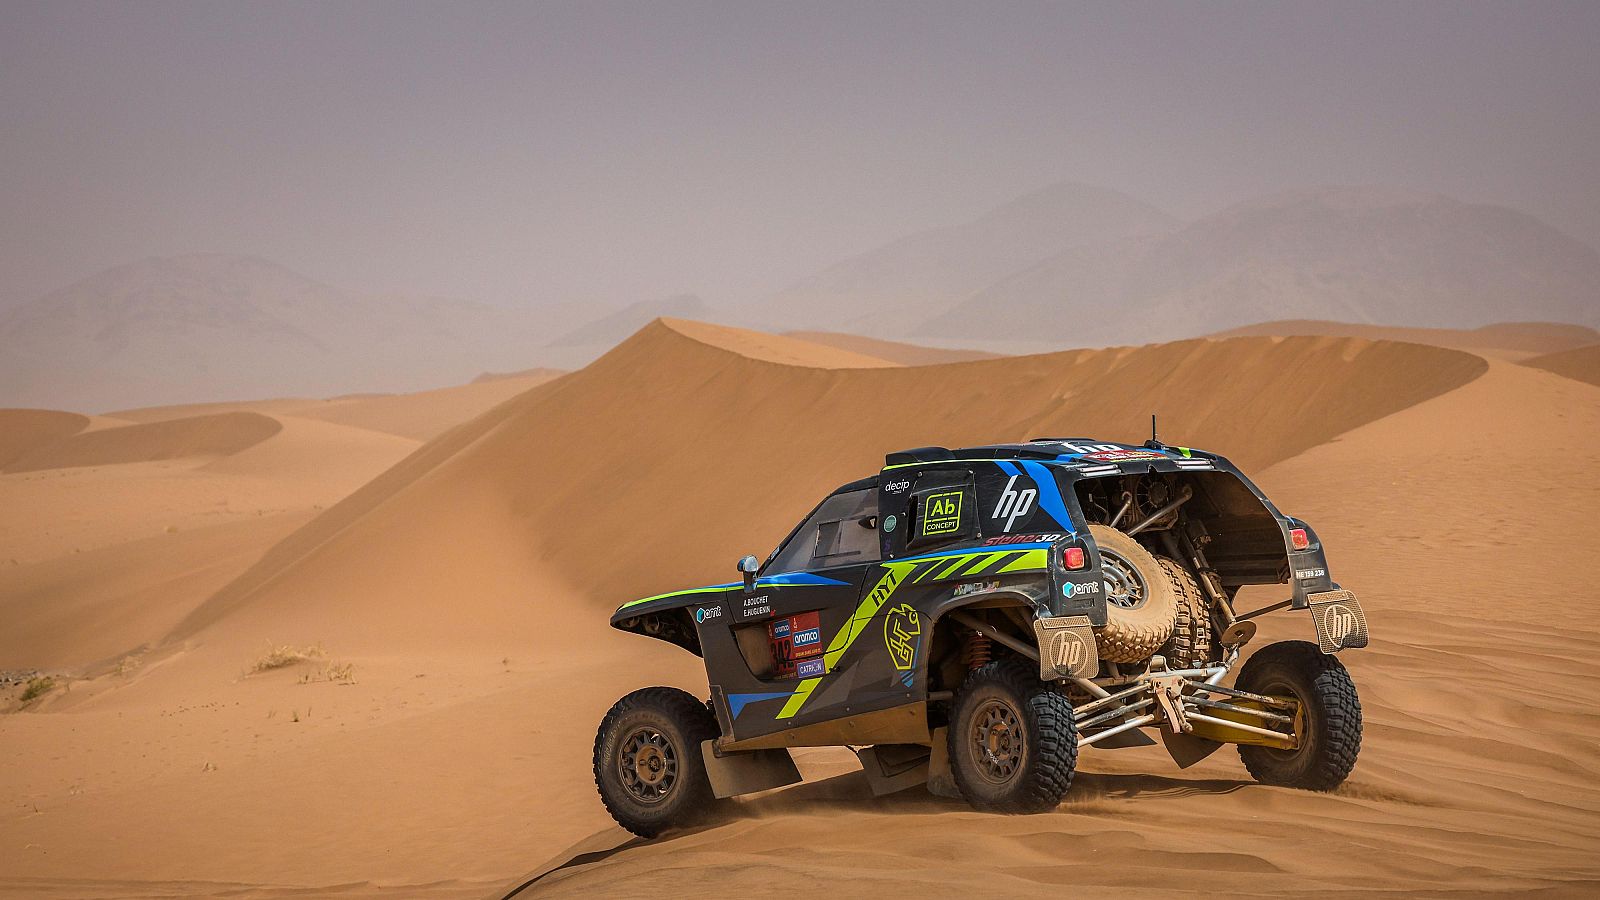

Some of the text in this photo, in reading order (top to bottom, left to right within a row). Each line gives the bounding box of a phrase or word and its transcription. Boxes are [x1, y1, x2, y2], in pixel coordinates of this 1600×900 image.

[885, 479, 909, 491] decip
[930, 498, 955, 516] Ab
[991, 474, 1037, 532] hp
[926, 521, 956, 531] CONCEPT
[871, 570, 897, 607] HYT
[1075, 582, 1099, 594] amt
[775, 625, 789, 634] aramco
[1332, 606, 1352, 643] hp
[794, 631, 818, 644] aramco
[1057, 631, 1081, 669] hp
